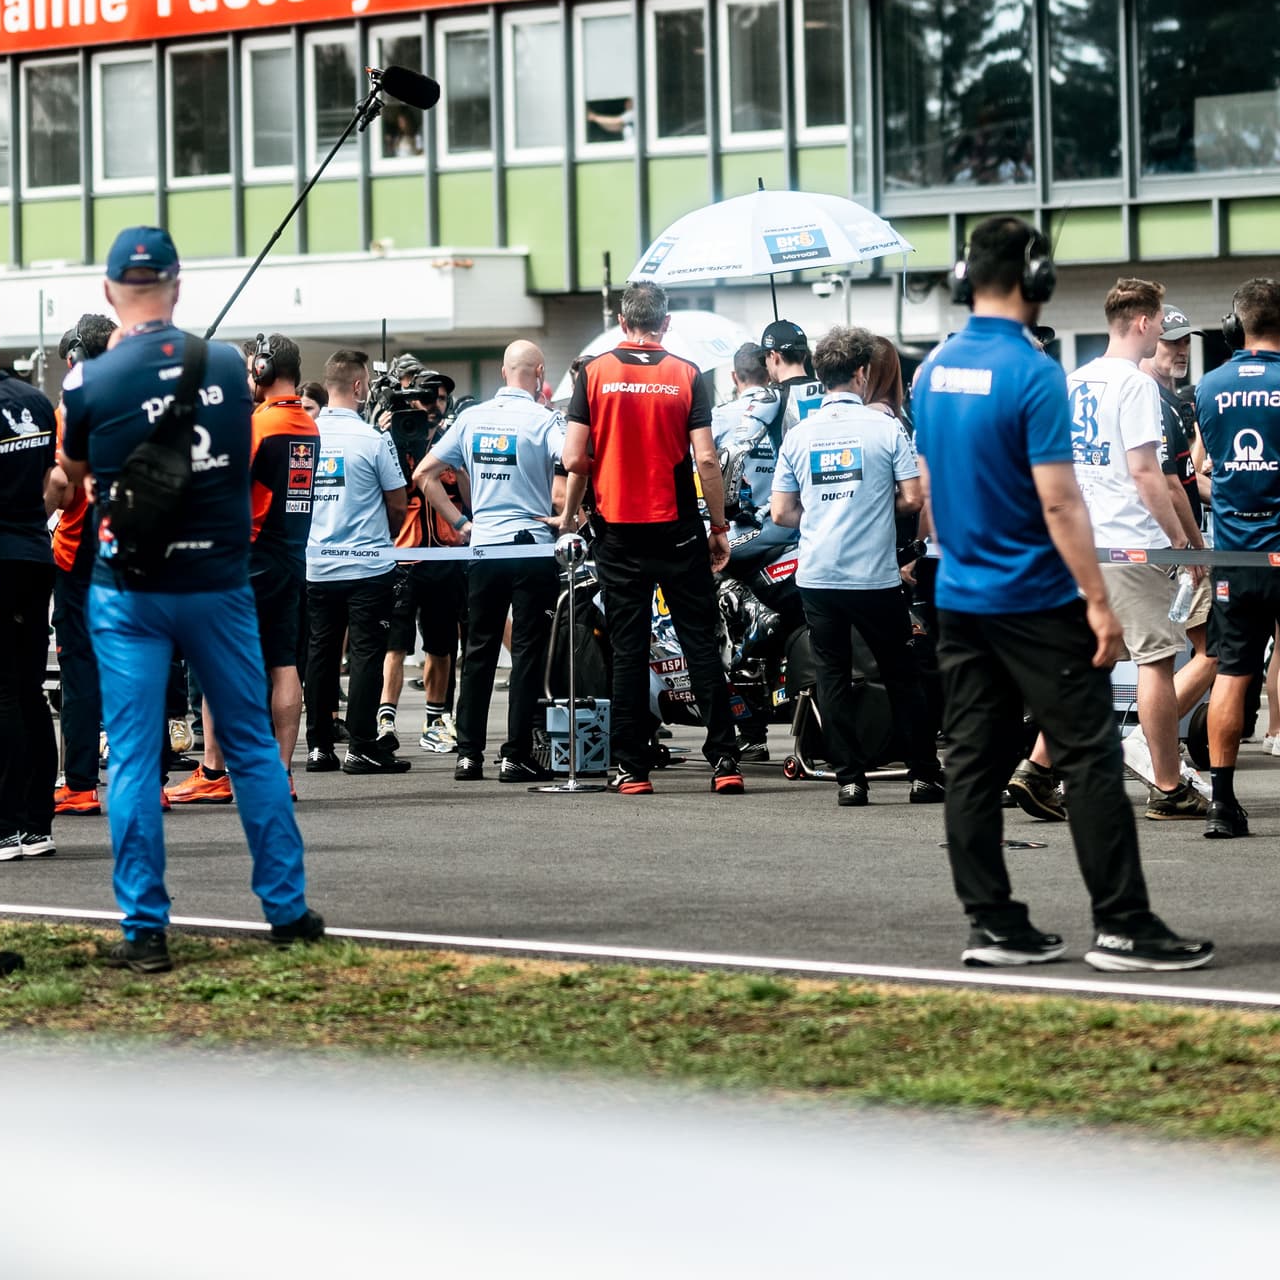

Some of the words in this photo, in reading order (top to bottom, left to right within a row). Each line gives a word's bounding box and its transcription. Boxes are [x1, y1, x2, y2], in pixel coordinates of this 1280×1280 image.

[1224, 460, 1280, 472] PRAMAC
[480, 472, 511, 481] DUCATI
[821, 489, 855, 501] DUCATI
[320, 549, 350, 558] GRESINI
[350, 549, 380, 558] RACING
